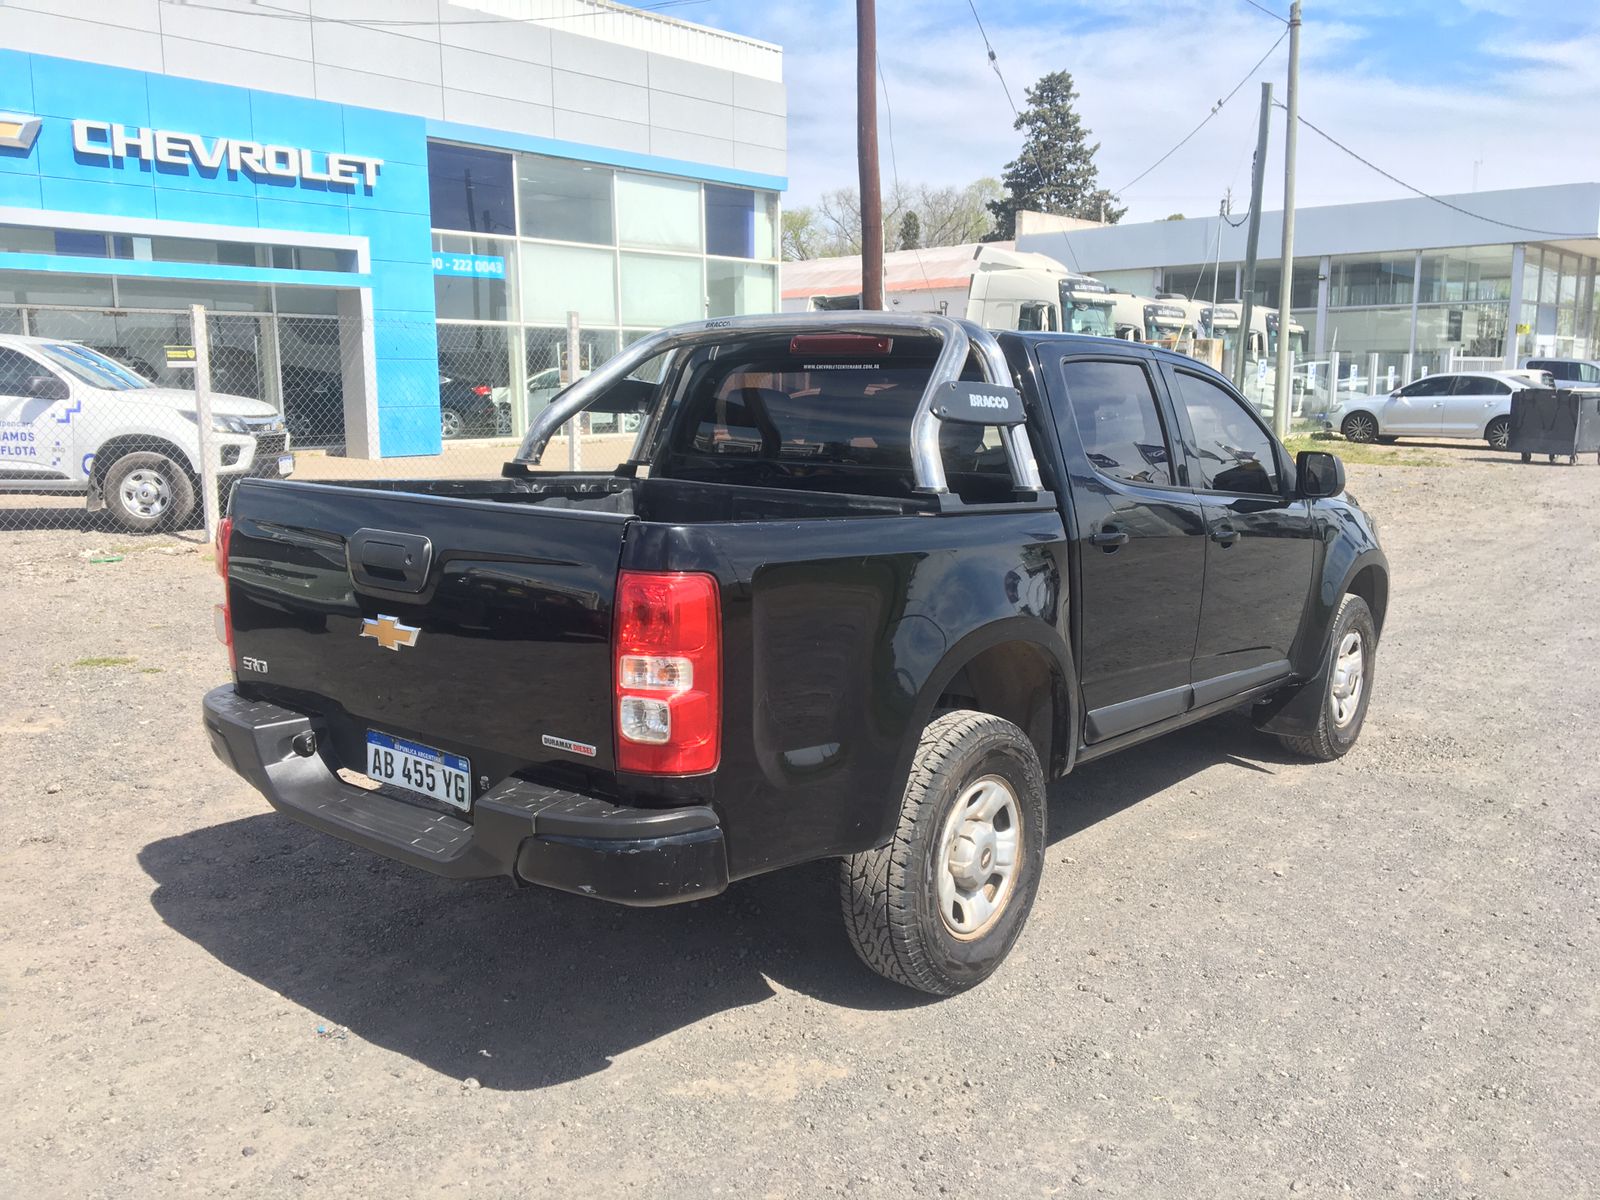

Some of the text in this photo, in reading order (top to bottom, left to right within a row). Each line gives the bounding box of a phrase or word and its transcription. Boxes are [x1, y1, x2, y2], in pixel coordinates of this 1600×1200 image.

[72, 119, 384, 186] CHEVROLET
[453, 258, 472, 272] 222
[475, 260, 502, 273] 0043
[968, 393, 1009, 409] BRACCO
[0, 431, 35, 441] AMOS
[1, 446, 36, 455] FLOTA
[543, 737, 594, 755] DURAMAX DIESEL
[372, 748, 465, 802] AB 455 YG
